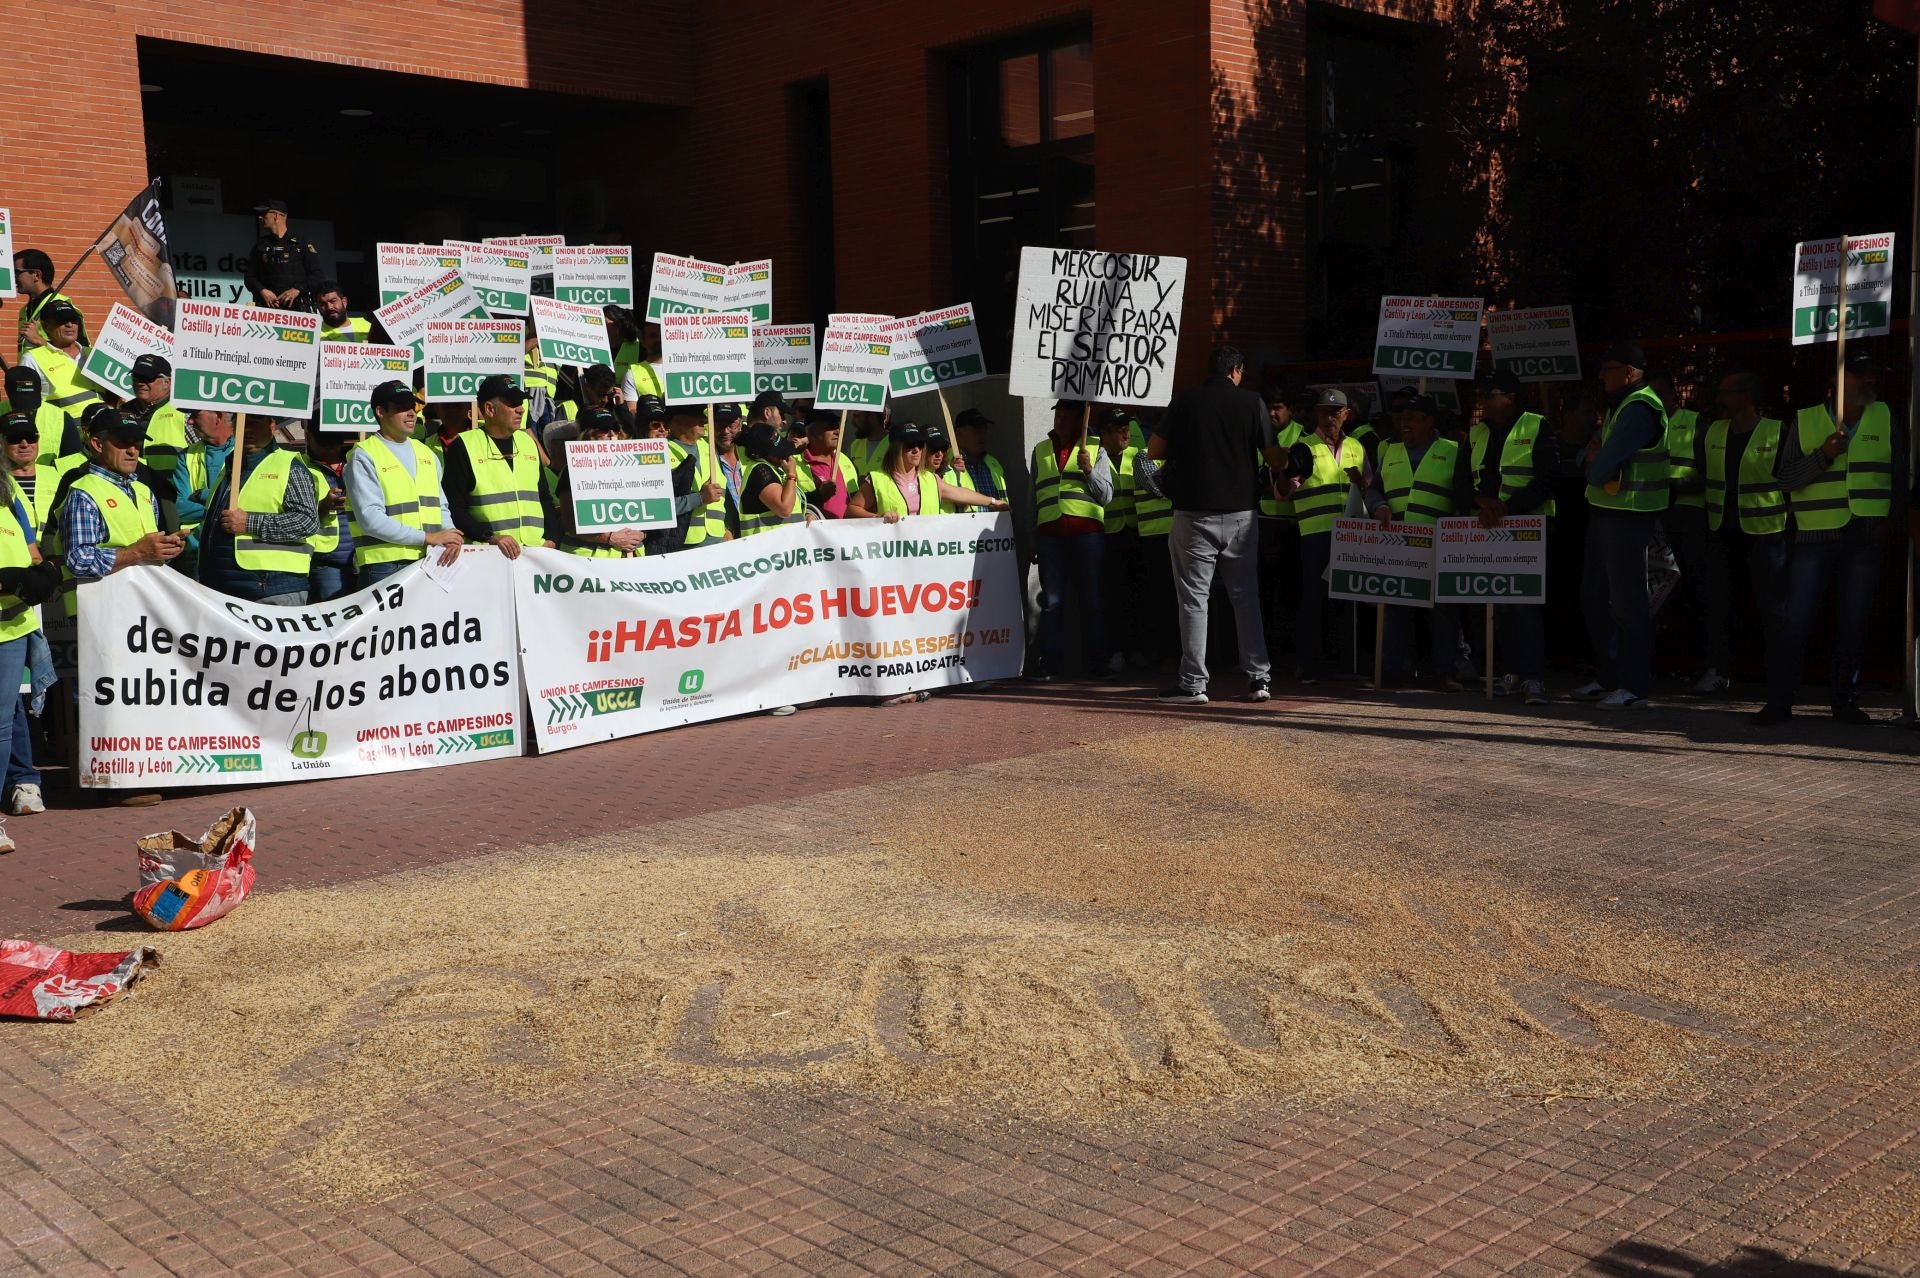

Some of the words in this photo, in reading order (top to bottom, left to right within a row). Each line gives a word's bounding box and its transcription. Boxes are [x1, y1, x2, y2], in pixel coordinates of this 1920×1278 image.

[1800, 244, 1823, 256] UNION
[1825, 242, 1835, 252] DE
[1864, 252, 1886, 262] UCCL
[174, 253, 207, 271] nta
[217, 253, 249, 273] de
[1052, 250, 1160, 282] MERCOSUR
[177, 279, 221, 298] tilla
[229, 284, 244, 304] y
[569, 289, 617, 304] UCCL
[1056, 279, 1134, 310] RUINA
[1154, 280, 1176, 311] Y
[1386, 298, 1412, 307] UNION
[1414, 299, 1425, 308] DE
[1427, 299, 1480, 310] CAMPESINOS
[182, 303, 220, 317] UNION
[223, 308, 239, 319] DE
[242, 311, 317, 329] CAMPESINOS
[664, 316, 688, 326] UNION
[690, 315, 701, 325] DE
[702, 315, 749, 325] CAMPESINOS
[879, 322, 905, 335] UNION
[907, 319, 919, 330] DE
[920, 306, 970, 327] CAMPESINOS
[1029, 303, 1117, 332] MISERIA
[1122, 308, 1177, 336] PARA
[181, 318, 213, 332] Castilla
[214, 325, 221, 337] y
[222, 324, 242, 336] León
[282, 331, 310, 342] UCCL
[427, 322, 453, 331] UNION
[455, 322, 466, 331] DE
[467, 322, 522, 332] CAMPESINOS
[665, 330, 685, 341] Castilla
[691, 329, 704, 340] León
[727, 328, 746, 338] UCCL
[427, 333, 449, 344] Castilla
[455, 333, 469, 344] León
[497, 334, 518, 343] UCCL
[189, 346, 213, 360] Título
[214, 349, 252, 365] Principal,
[253, 356, 274, 365] como
[276, 356, 307, 371] siempre
[553, 342, 600, 363] UCCL
[1038, 331, 1070, 362] EL
[1071, 332, 1166, 370] SECTOR
[1393, 349, 1455, 370] UCCL
[904, 361, 967, 387] UCCL
[1510, 358, 1564, 375] UCCL
[198, 376, 285, 405] UCCL
[681, 374, 736, 396] UCCL
[1051, 361, 1151, 399] PRIMARIO
[827, 382, 869, 403] UCCL
[569, 444, 595, 453] UNION
[597, 443, 608, 452] DE
[609, 442, 664, 453] CAMPESINOS
[571, 456, 592, 468] Castilla
[598, 456, 613, 468] León
[641, 454, 663, 464] UCCL
[591, 501, 655, 523] UCCL
[1336, 520, 1363, 530] UNION
[1365, 523, 1377, 531] DE
[1441, 520, 1468, 529] UNION
[534, 574, 574, 594] NO
[578, 578, 606, 593] AL
[609, 579, 687, 595] ACUERDO
[689, 547, 812, 591] MERCOSUR,
[814, 547, 836, 562] ES
[841, 543, 864, 561] LA
[867, 539, 933, 559] RUINA
[938, 541, 965, 556] DEL
[1348, 574, 1413, 597] UCCL
[1456, 575, 1523, 595] UCCL
[225, 602, 364, 633] Contra
[372, 583, 405, 612] la
[752, 593, 815, 635] LOS
[820, 579, 983, 620] HUEVOS!!
[127, 612, 482, 677] desproporcionada
[915, 630, 976, 655] ESPEJO
[980, 628, 1010, 648] YA!!
[838, 660, 872, 678] PAC
[876, 653, 913, 677] PARA
[916, 648, 939, 668] LOS
[938, 645, 967, 666] ATPs
[94, 668, 230, 707] subida
[247, 680, 299, 713] de
[313, 680, 366, 711] los
[379, 661, 510, 702] abonos
[540, 685, 567, 699] UNION
[569, 682, 581, 694] DE
[583, 677, 646, 692] CAMPESINOS
[596, 691, 637, 712] UCCL
[356, 726, 400, 743] UNION
[404, 722, 422, 739] DE
[426, 712, 514, 738] CAMPESINOS
[547, 722, 578, 735] Burgos
[90, 736, 141, 752] UNION
[145, 737, 164, 751] DE
[167, 735, 261, 751] CAMPESINOS
[479, 733, 510, 747] UCCL
[400, 747, 406, 761] y
[408, 741, 434, 757] León
[90, 757, 135, 775] Castilla
[138, 761, 145, 778] y
[147, 757, 173, 774] León
[223, 757, 260, 771] UCCL
[292, 761, 302, 771] La
[303, 758, 331, 770] Unión
